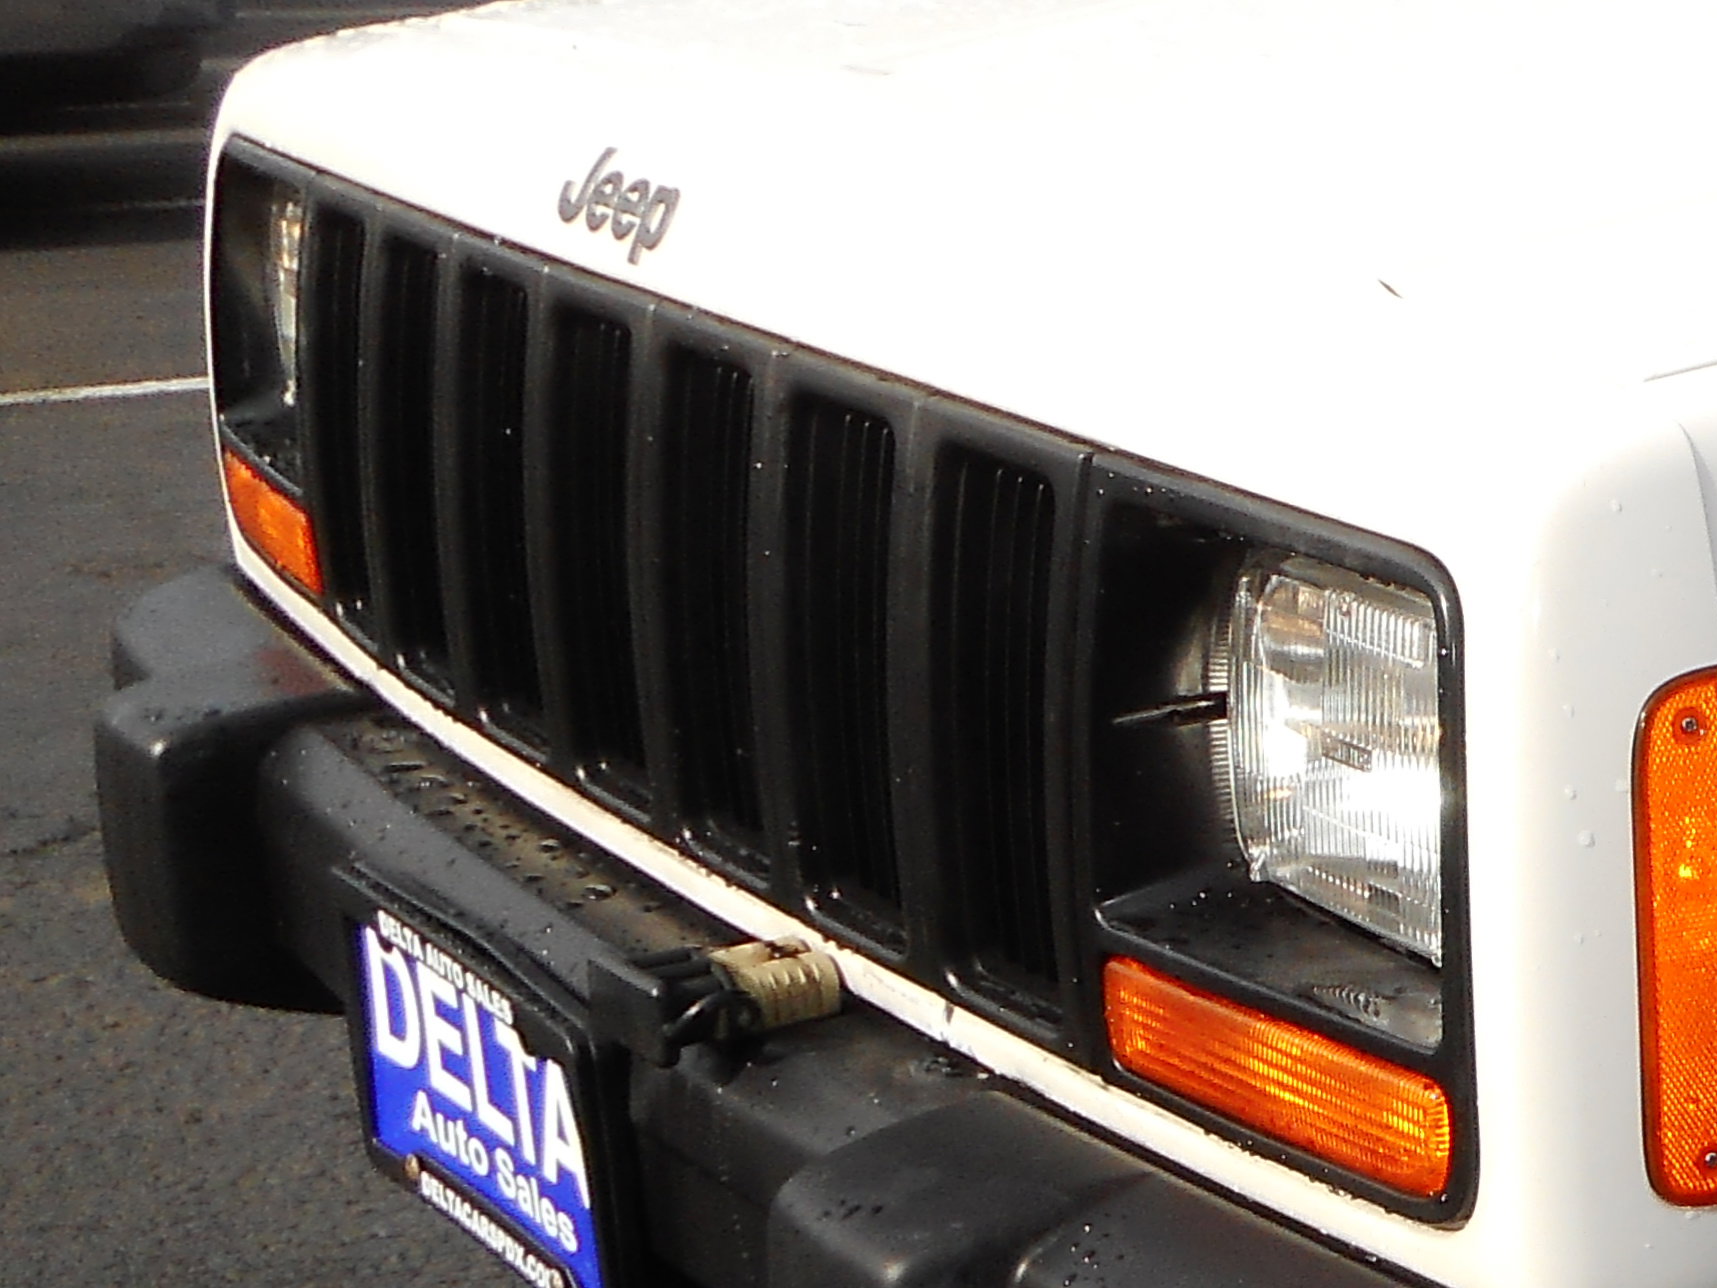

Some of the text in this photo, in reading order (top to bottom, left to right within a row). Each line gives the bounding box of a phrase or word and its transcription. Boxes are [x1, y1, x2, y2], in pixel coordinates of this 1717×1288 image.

[558, 146, 681, 266] Jeep
[377, 909, 514, 1026] DELTA AUTO SALES
[365, 925, 591, 1210] DELTA
[411, 1089, 579, 1253] Auto Sales
